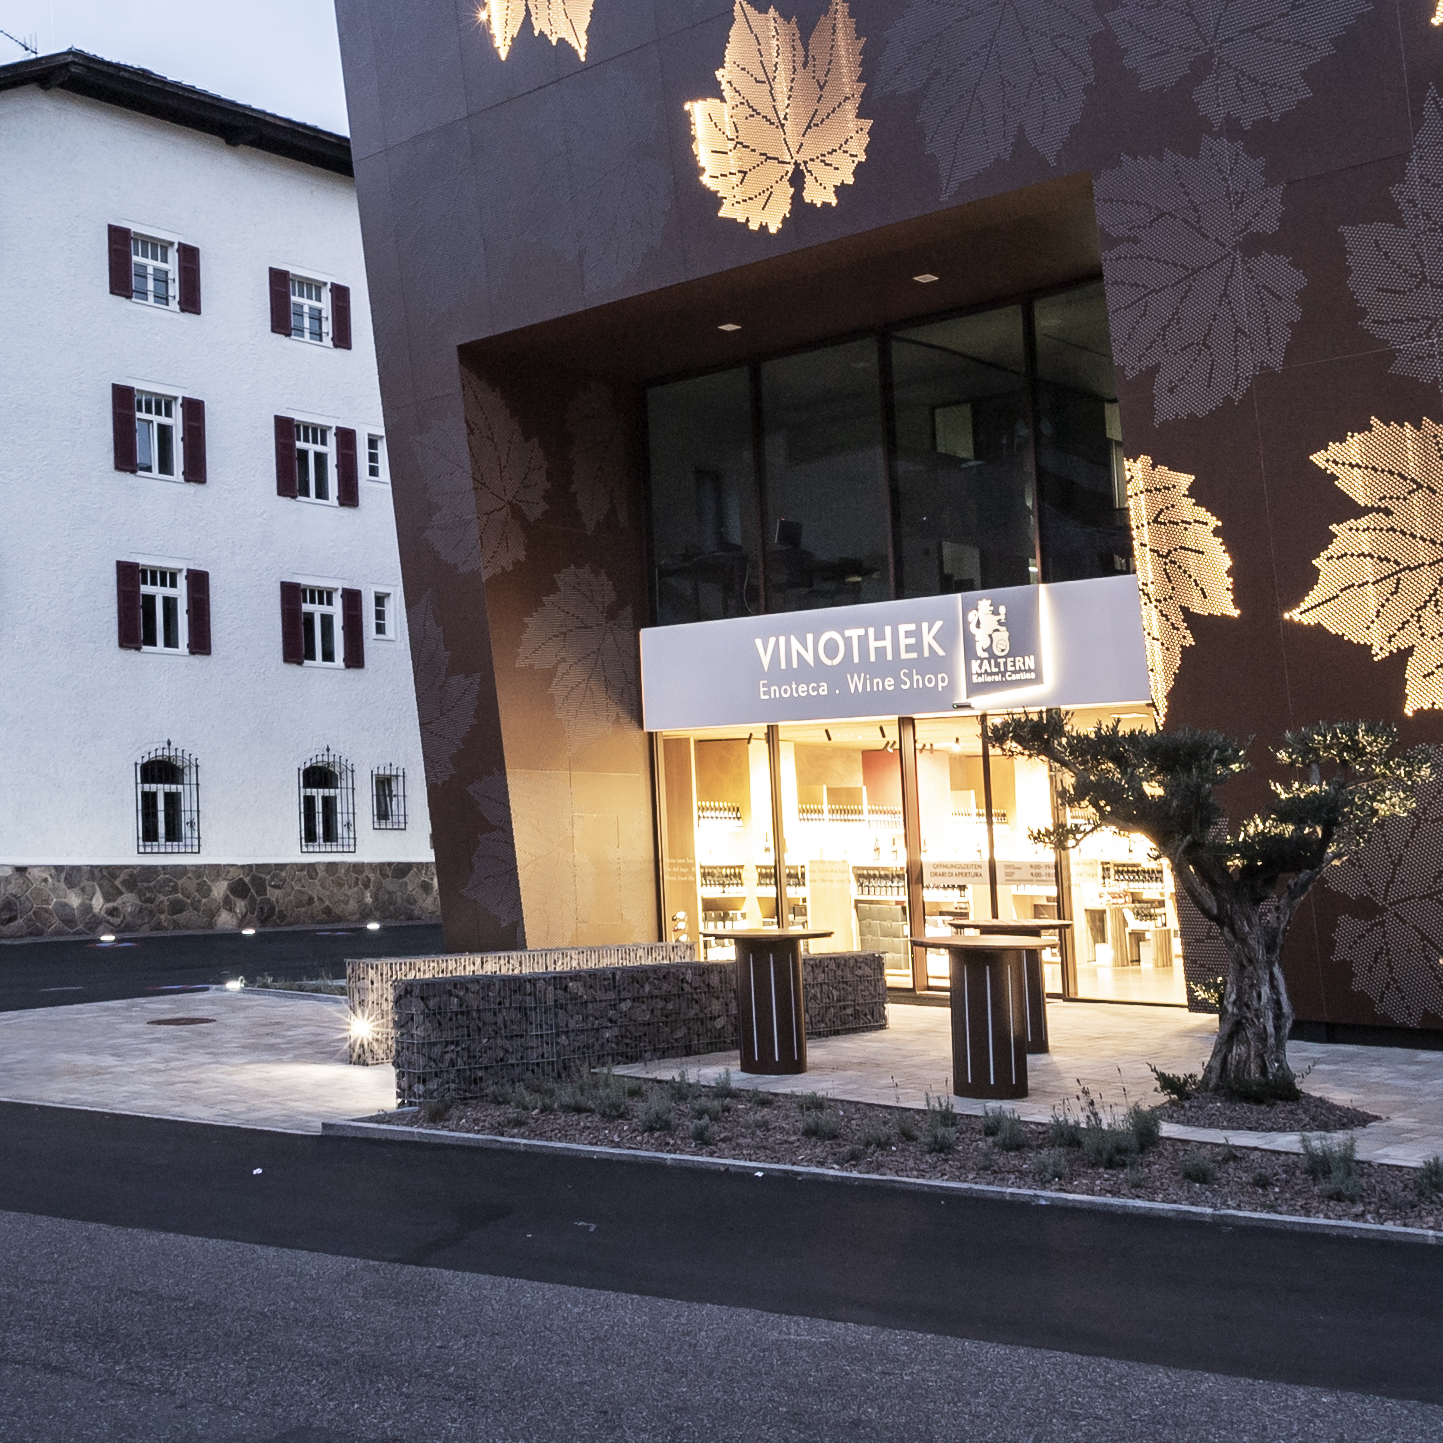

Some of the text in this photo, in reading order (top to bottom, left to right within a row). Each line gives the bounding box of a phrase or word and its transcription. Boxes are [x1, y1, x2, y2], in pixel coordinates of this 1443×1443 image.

[754, 620, 946, 673] VINOTHEK
[971, 655, 1035, 674] KALTERN
[759, 680, 828, 700] Enoteca
[846, 672, 895, 694] Wine
[900, 668, 949, 692] Shop
[929, 870, 947, 878] ORARI
